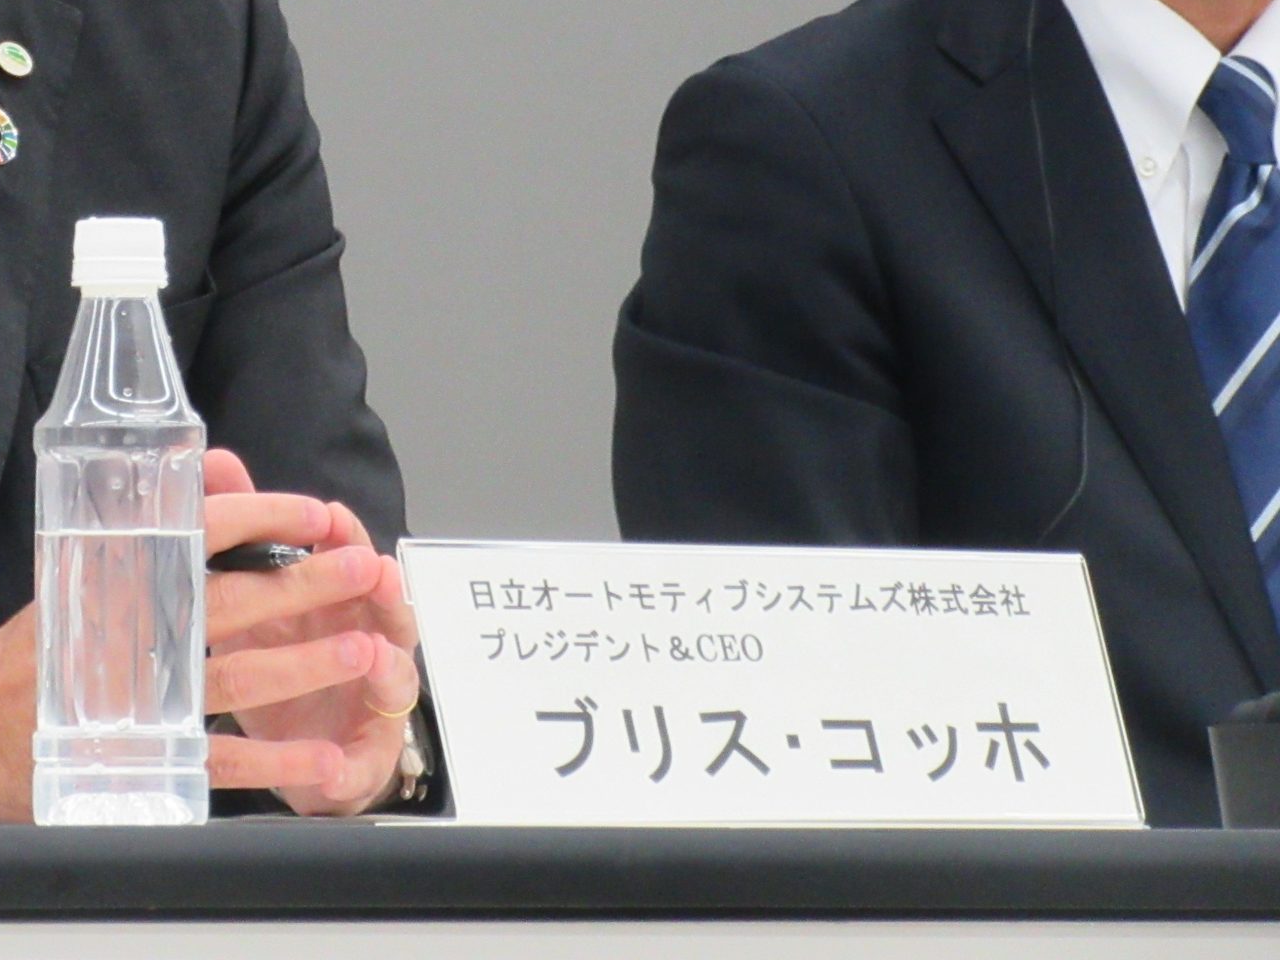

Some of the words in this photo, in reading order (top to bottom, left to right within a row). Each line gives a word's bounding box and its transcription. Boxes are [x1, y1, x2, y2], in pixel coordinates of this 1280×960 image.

[469, 578, 1031, 618] 日立オートモティブシステムズ株式会社
[480, 627, 764, 664] プレジデント&CEO
